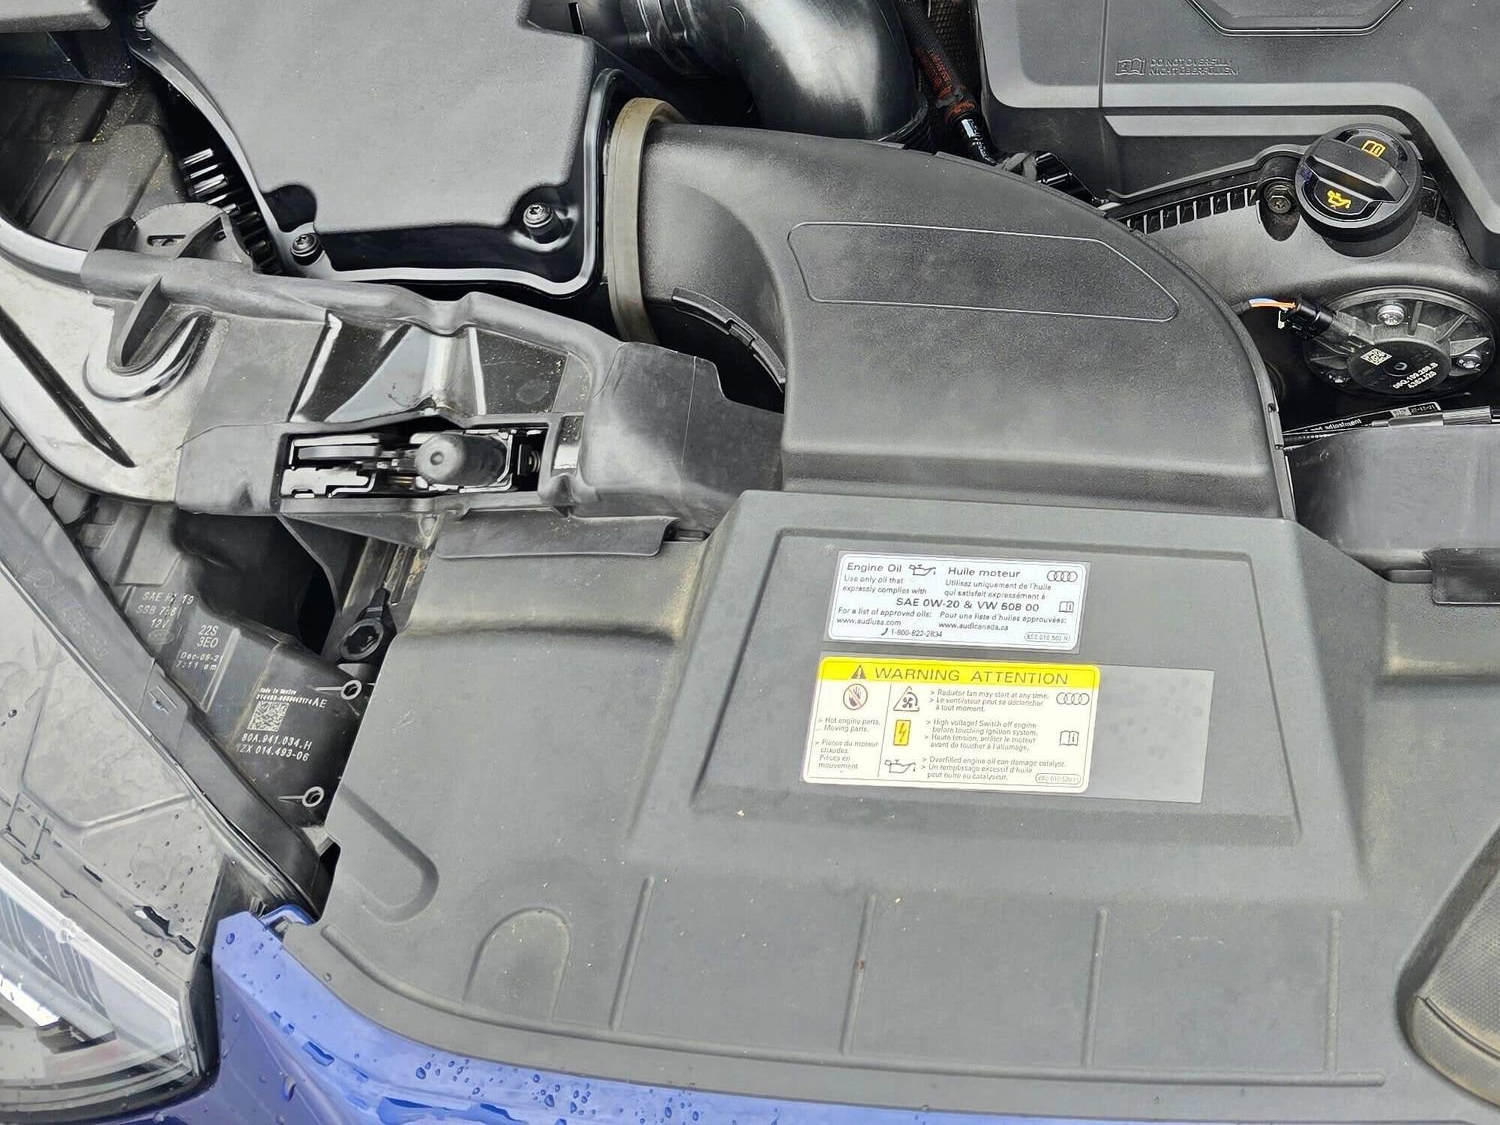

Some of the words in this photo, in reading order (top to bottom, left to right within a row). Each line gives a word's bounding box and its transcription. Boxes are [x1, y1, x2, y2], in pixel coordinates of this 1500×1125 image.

[847, 563, 885, 573] Engine
[888, 564, 902, 573] Oil
[948, 567, 976, 576] Huile
[979, 570, 1021, 578] moteur
[861, 576, 876, 585] only
[889, 577, 904, 585] that
[973, 581, 1017, 590] uniquement
[843, 586, 875, 594] expressly
[877, 587, 910, 595] complies
[912, 587, 927, 595] with
[944, 589, 956, 598] qui
[136, 605, 156, 615] SSB
[896, 598, 920, 607] SAE
[965, 601, 972, 609] &
[977, 601, 998, 610] VW
[1025, 603, 1039, 612] 00
[881, 609, 914, 618] approved
[198, 625, 219, 636] 22S
[875, 667, 960, 682] WARNING
[970, 671, 1068, 685] ATTENTION
[312, 698, 328, 708] AE
[933, 719, 949, 727] High
[242, 733, 312, 751] 80A.941.034.H
[962, 758, 986, 766] engine
